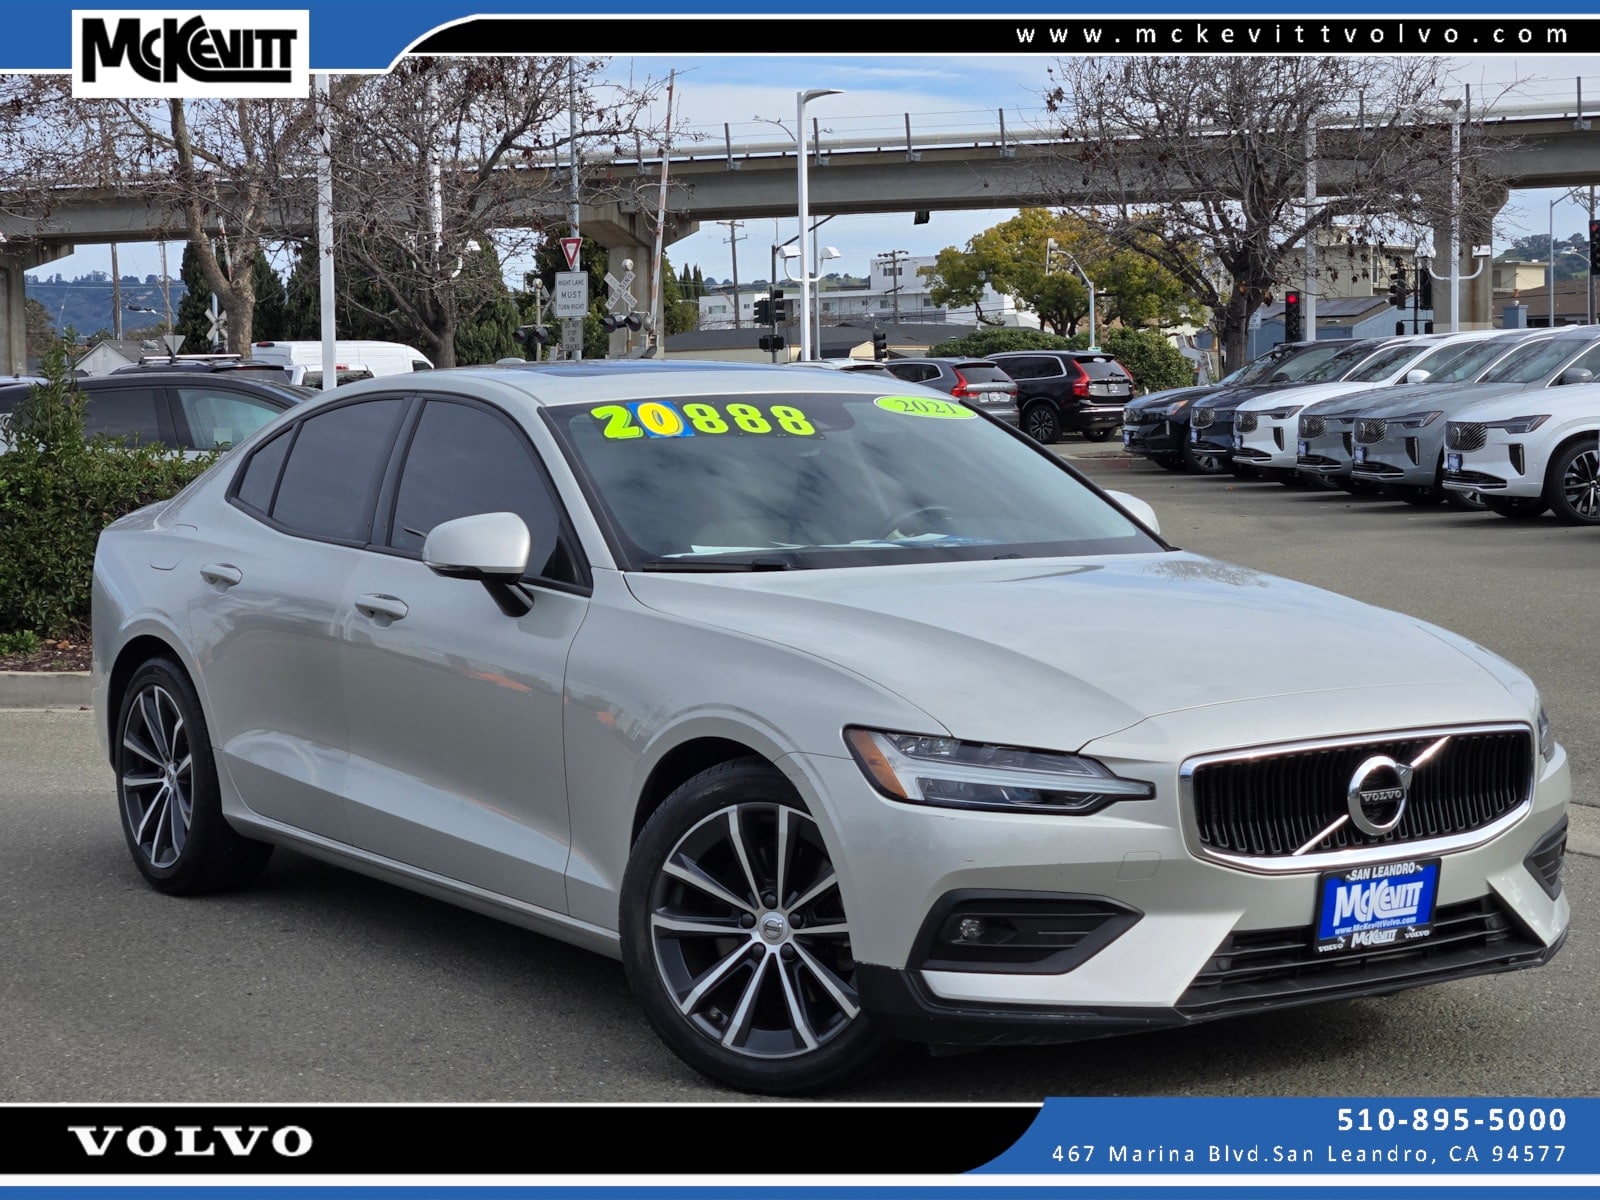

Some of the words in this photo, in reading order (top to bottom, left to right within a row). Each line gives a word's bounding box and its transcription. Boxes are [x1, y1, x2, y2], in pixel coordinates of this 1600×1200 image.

[561, 291, 582, 299] MUST
[607, 273, 633, 307] CROSSING
[894, 399, 957, 415] 2021
[590, 402, 816, 439] 20888
[1361, 790, 1402, 802] VOLVO
[1351, 868, 1371, 881] SAN
[1372, 862, 1415, 879] LEANDRO
[1334, 916, 1417, 936] www.McKevittVolvo.com
[1317, 943, 1344, 953] VOLVO
[1404, 930, 1431, 939] VOLVO
